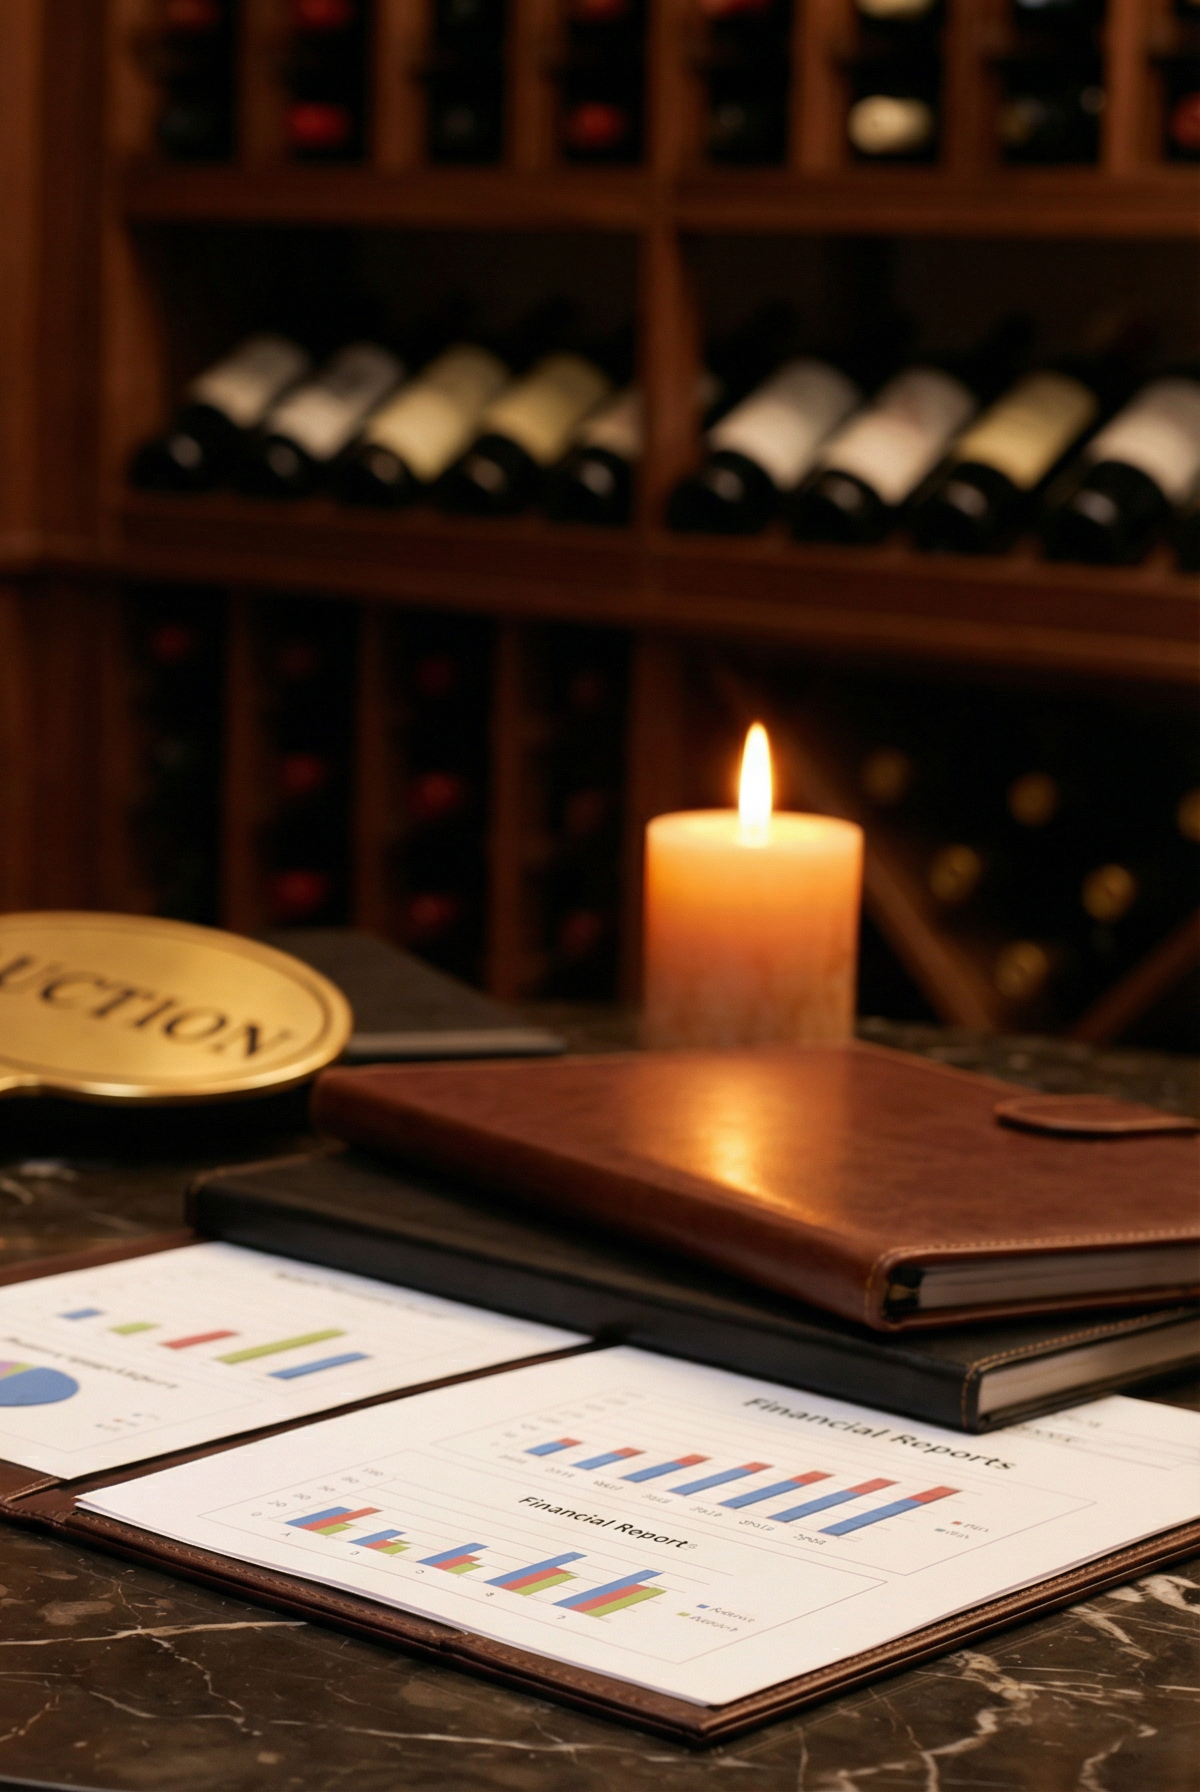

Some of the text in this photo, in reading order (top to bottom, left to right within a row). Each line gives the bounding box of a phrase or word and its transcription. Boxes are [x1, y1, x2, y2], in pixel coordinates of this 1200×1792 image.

[741, 1397, 893, 1439] Financial
[889, 1432, 1017, 1470] Reports
[518, 1495, 617, 1528] Financial
